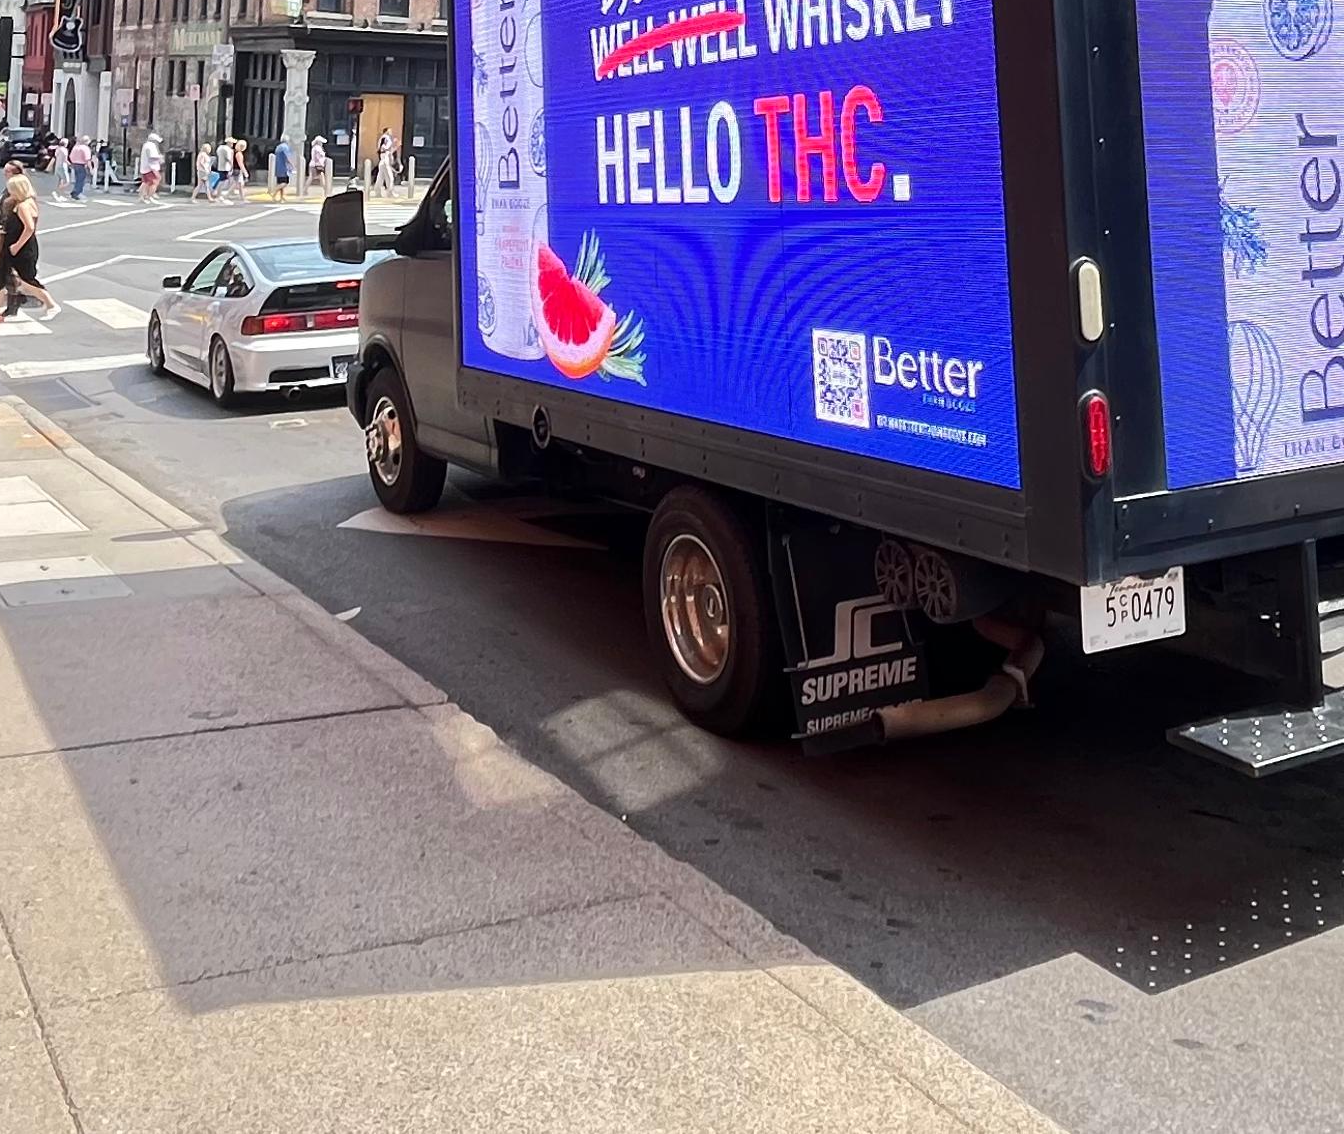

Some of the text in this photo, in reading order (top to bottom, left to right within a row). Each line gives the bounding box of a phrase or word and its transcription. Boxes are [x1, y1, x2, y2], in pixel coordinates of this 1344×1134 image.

[590, 16, 665, 82] WELL
[595, 84, 911, 205] HELLO THC.
[873, 335, 984, 399] Better
[801, 656, 918, 706] SUPREME
